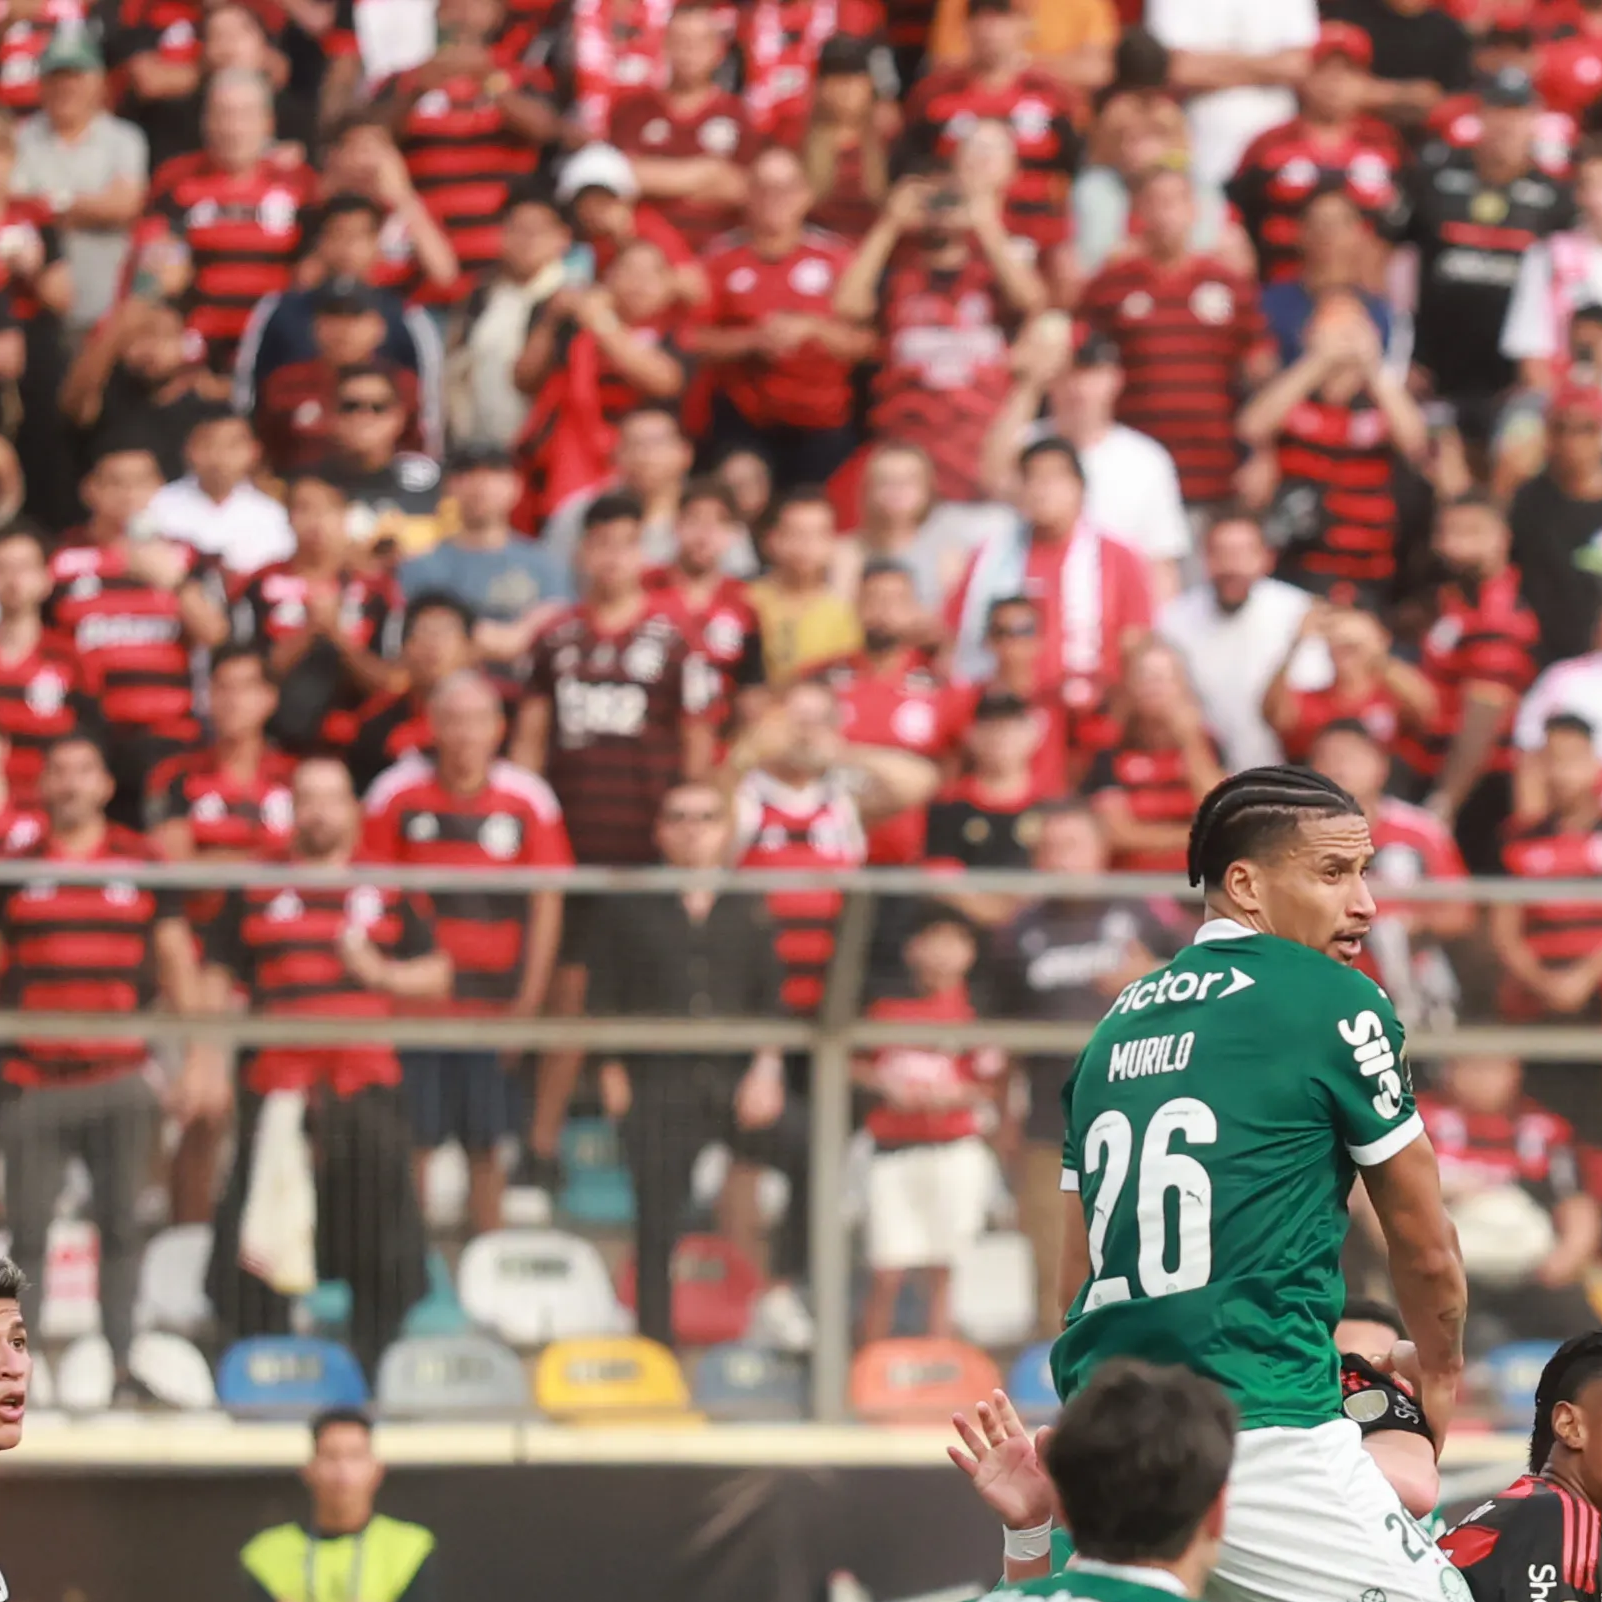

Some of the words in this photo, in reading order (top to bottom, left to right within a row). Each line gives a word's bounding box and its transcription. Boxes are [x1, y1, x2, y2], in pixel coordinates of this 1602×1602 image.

[1103, 968, 1224, 1020] Fictor
[1107, 1031, 1195, 1083] MURILO
[1082, 1096, 1217, 1315] 26
